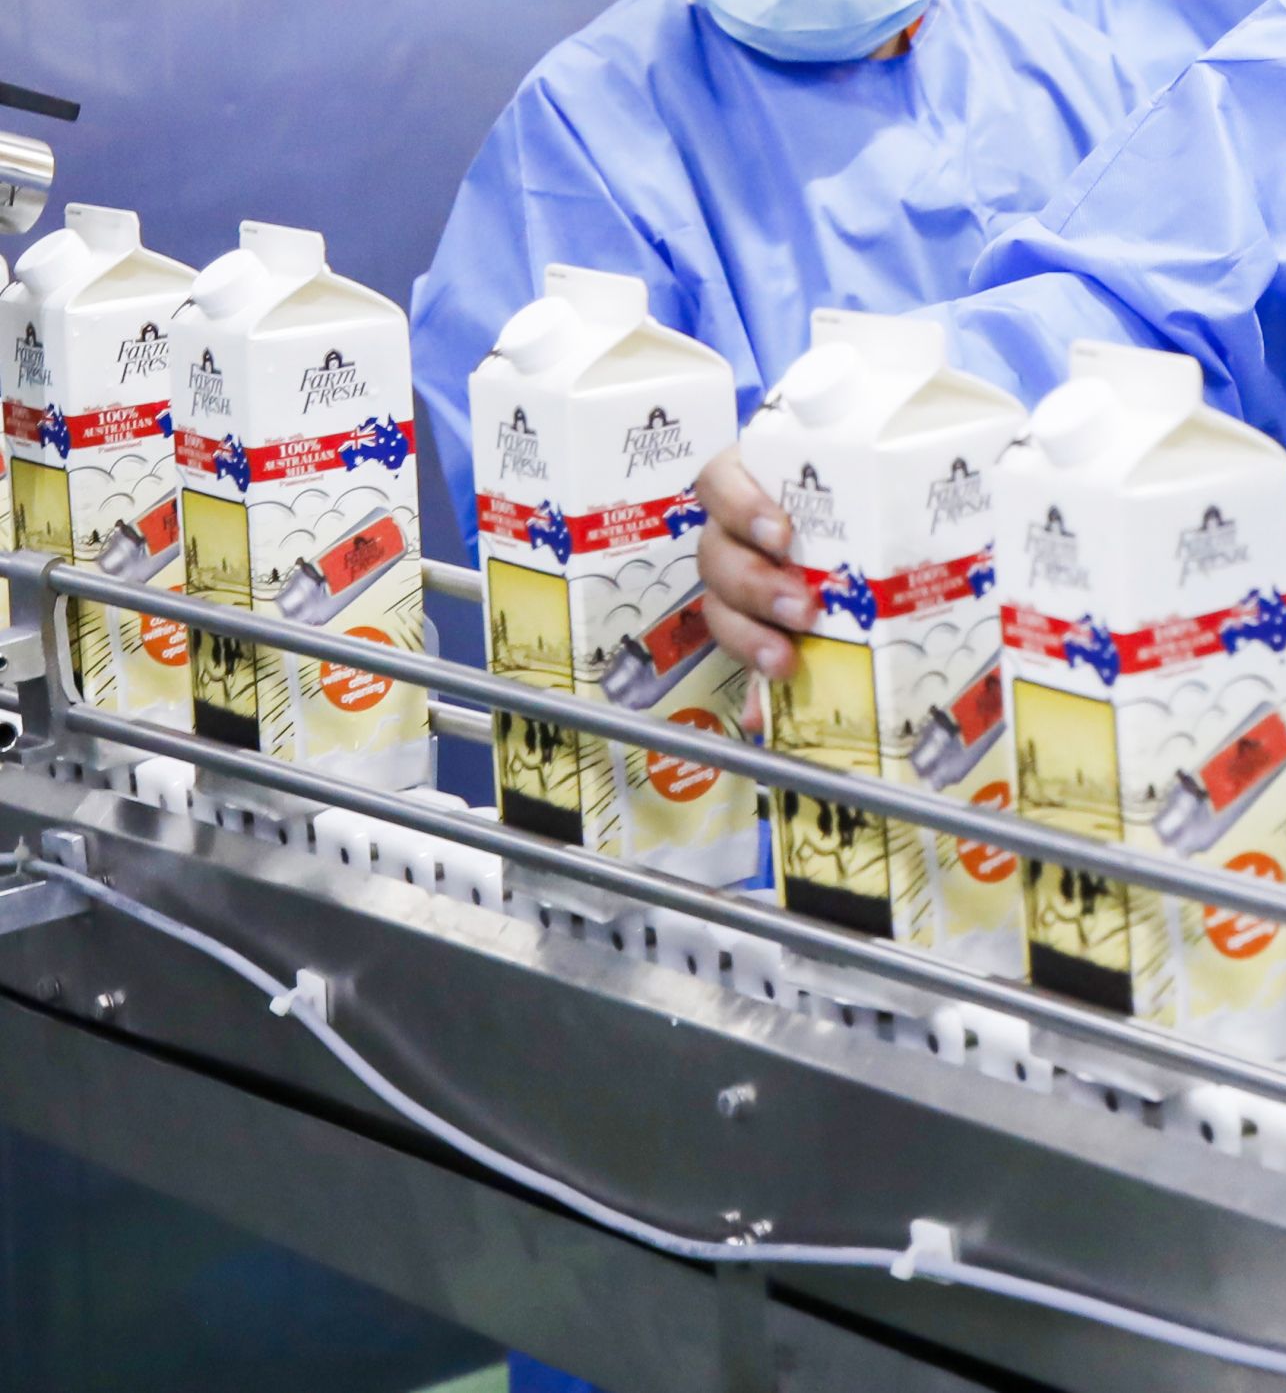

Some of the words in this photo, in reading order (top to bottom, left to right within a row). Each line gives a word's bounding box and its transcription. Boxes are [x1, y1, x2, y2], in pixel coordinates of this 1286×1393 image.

[97, 407, 139, 425] 100%
[82, 417, 153, 439] AUSTRALIAN
[279, 439, 321, 457] 100%
[263, 449, 336, 472] AUSTRALIAN
